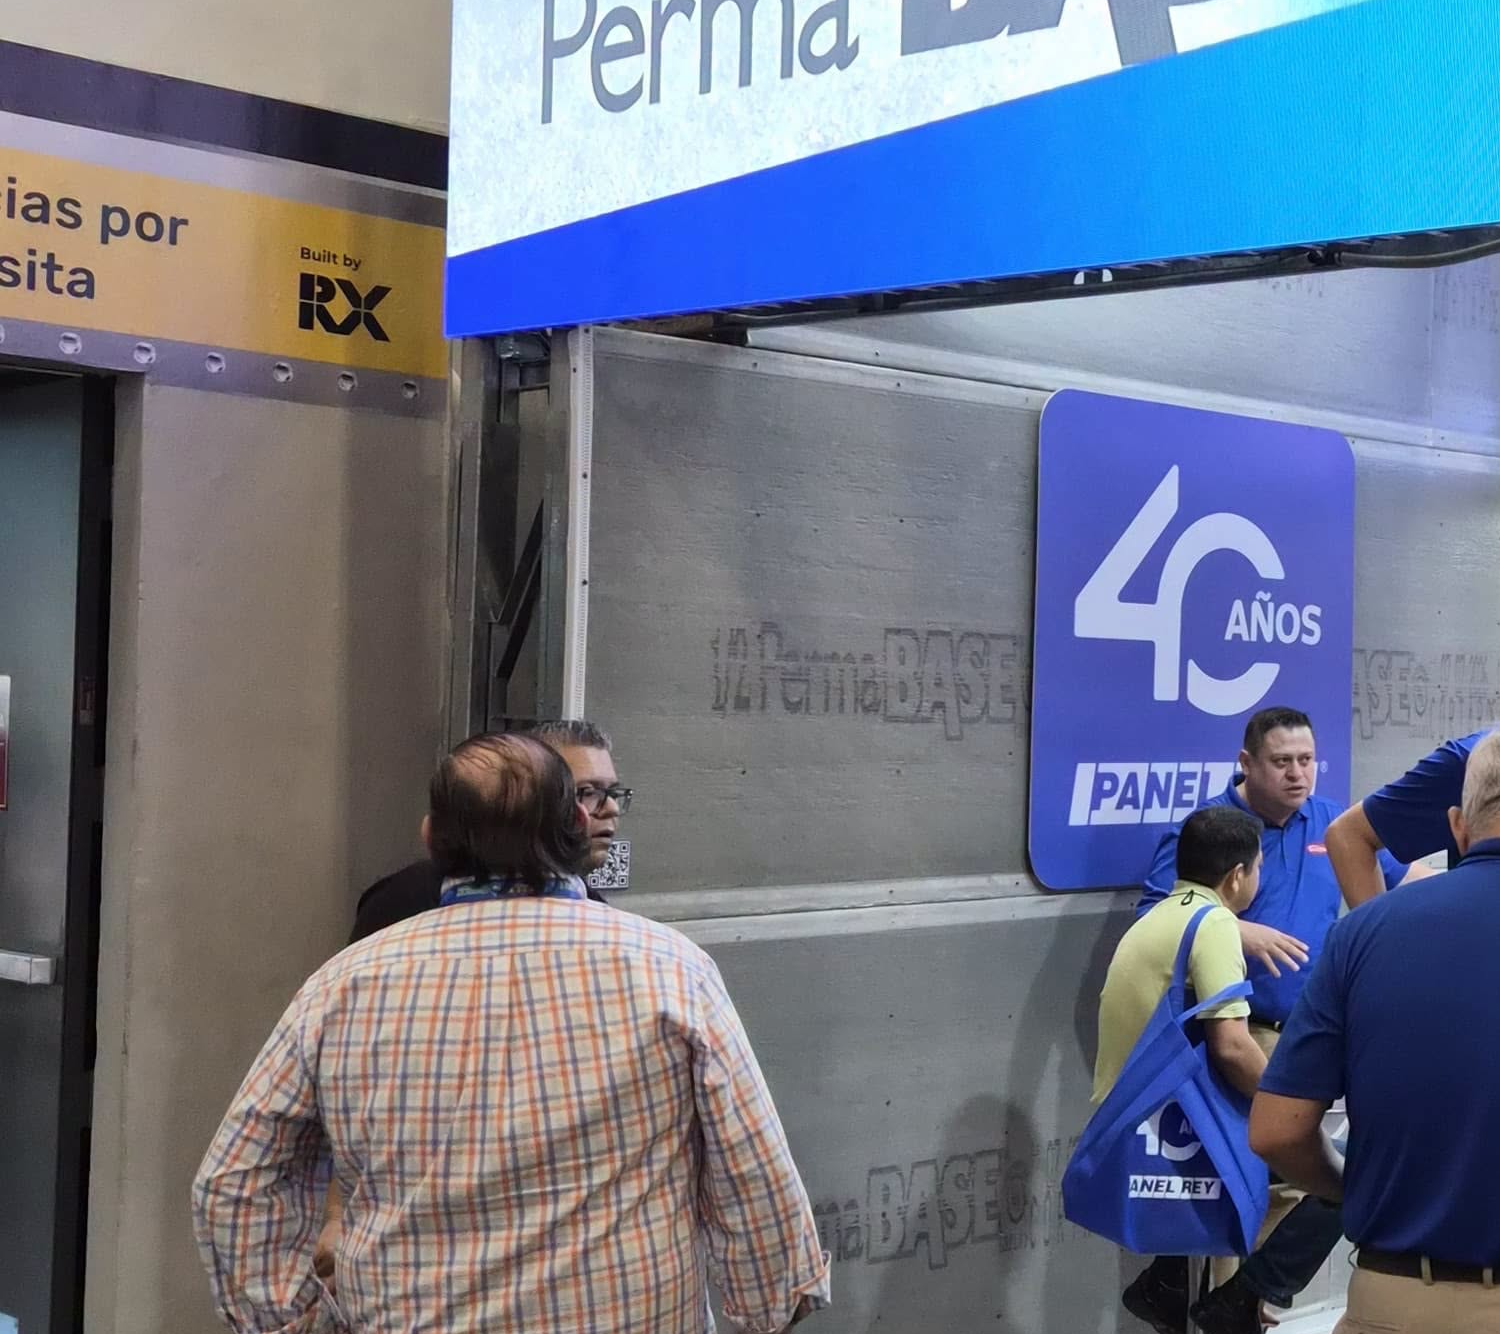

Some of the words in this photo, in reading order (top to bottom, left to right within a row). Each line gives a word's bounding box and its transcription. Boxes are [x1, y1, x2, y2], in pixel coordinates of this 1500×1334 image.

[0, 176, 83, 230] ias
[100, 203, 189, 245] por
[300, 246, 339, 266] Built
[343, 254, 362, 271] by
[299, 272, 392, 342] RX
[1224, 590, 1322, 646] AÑOS
[1180, 1178, 1216, 1195] REY
